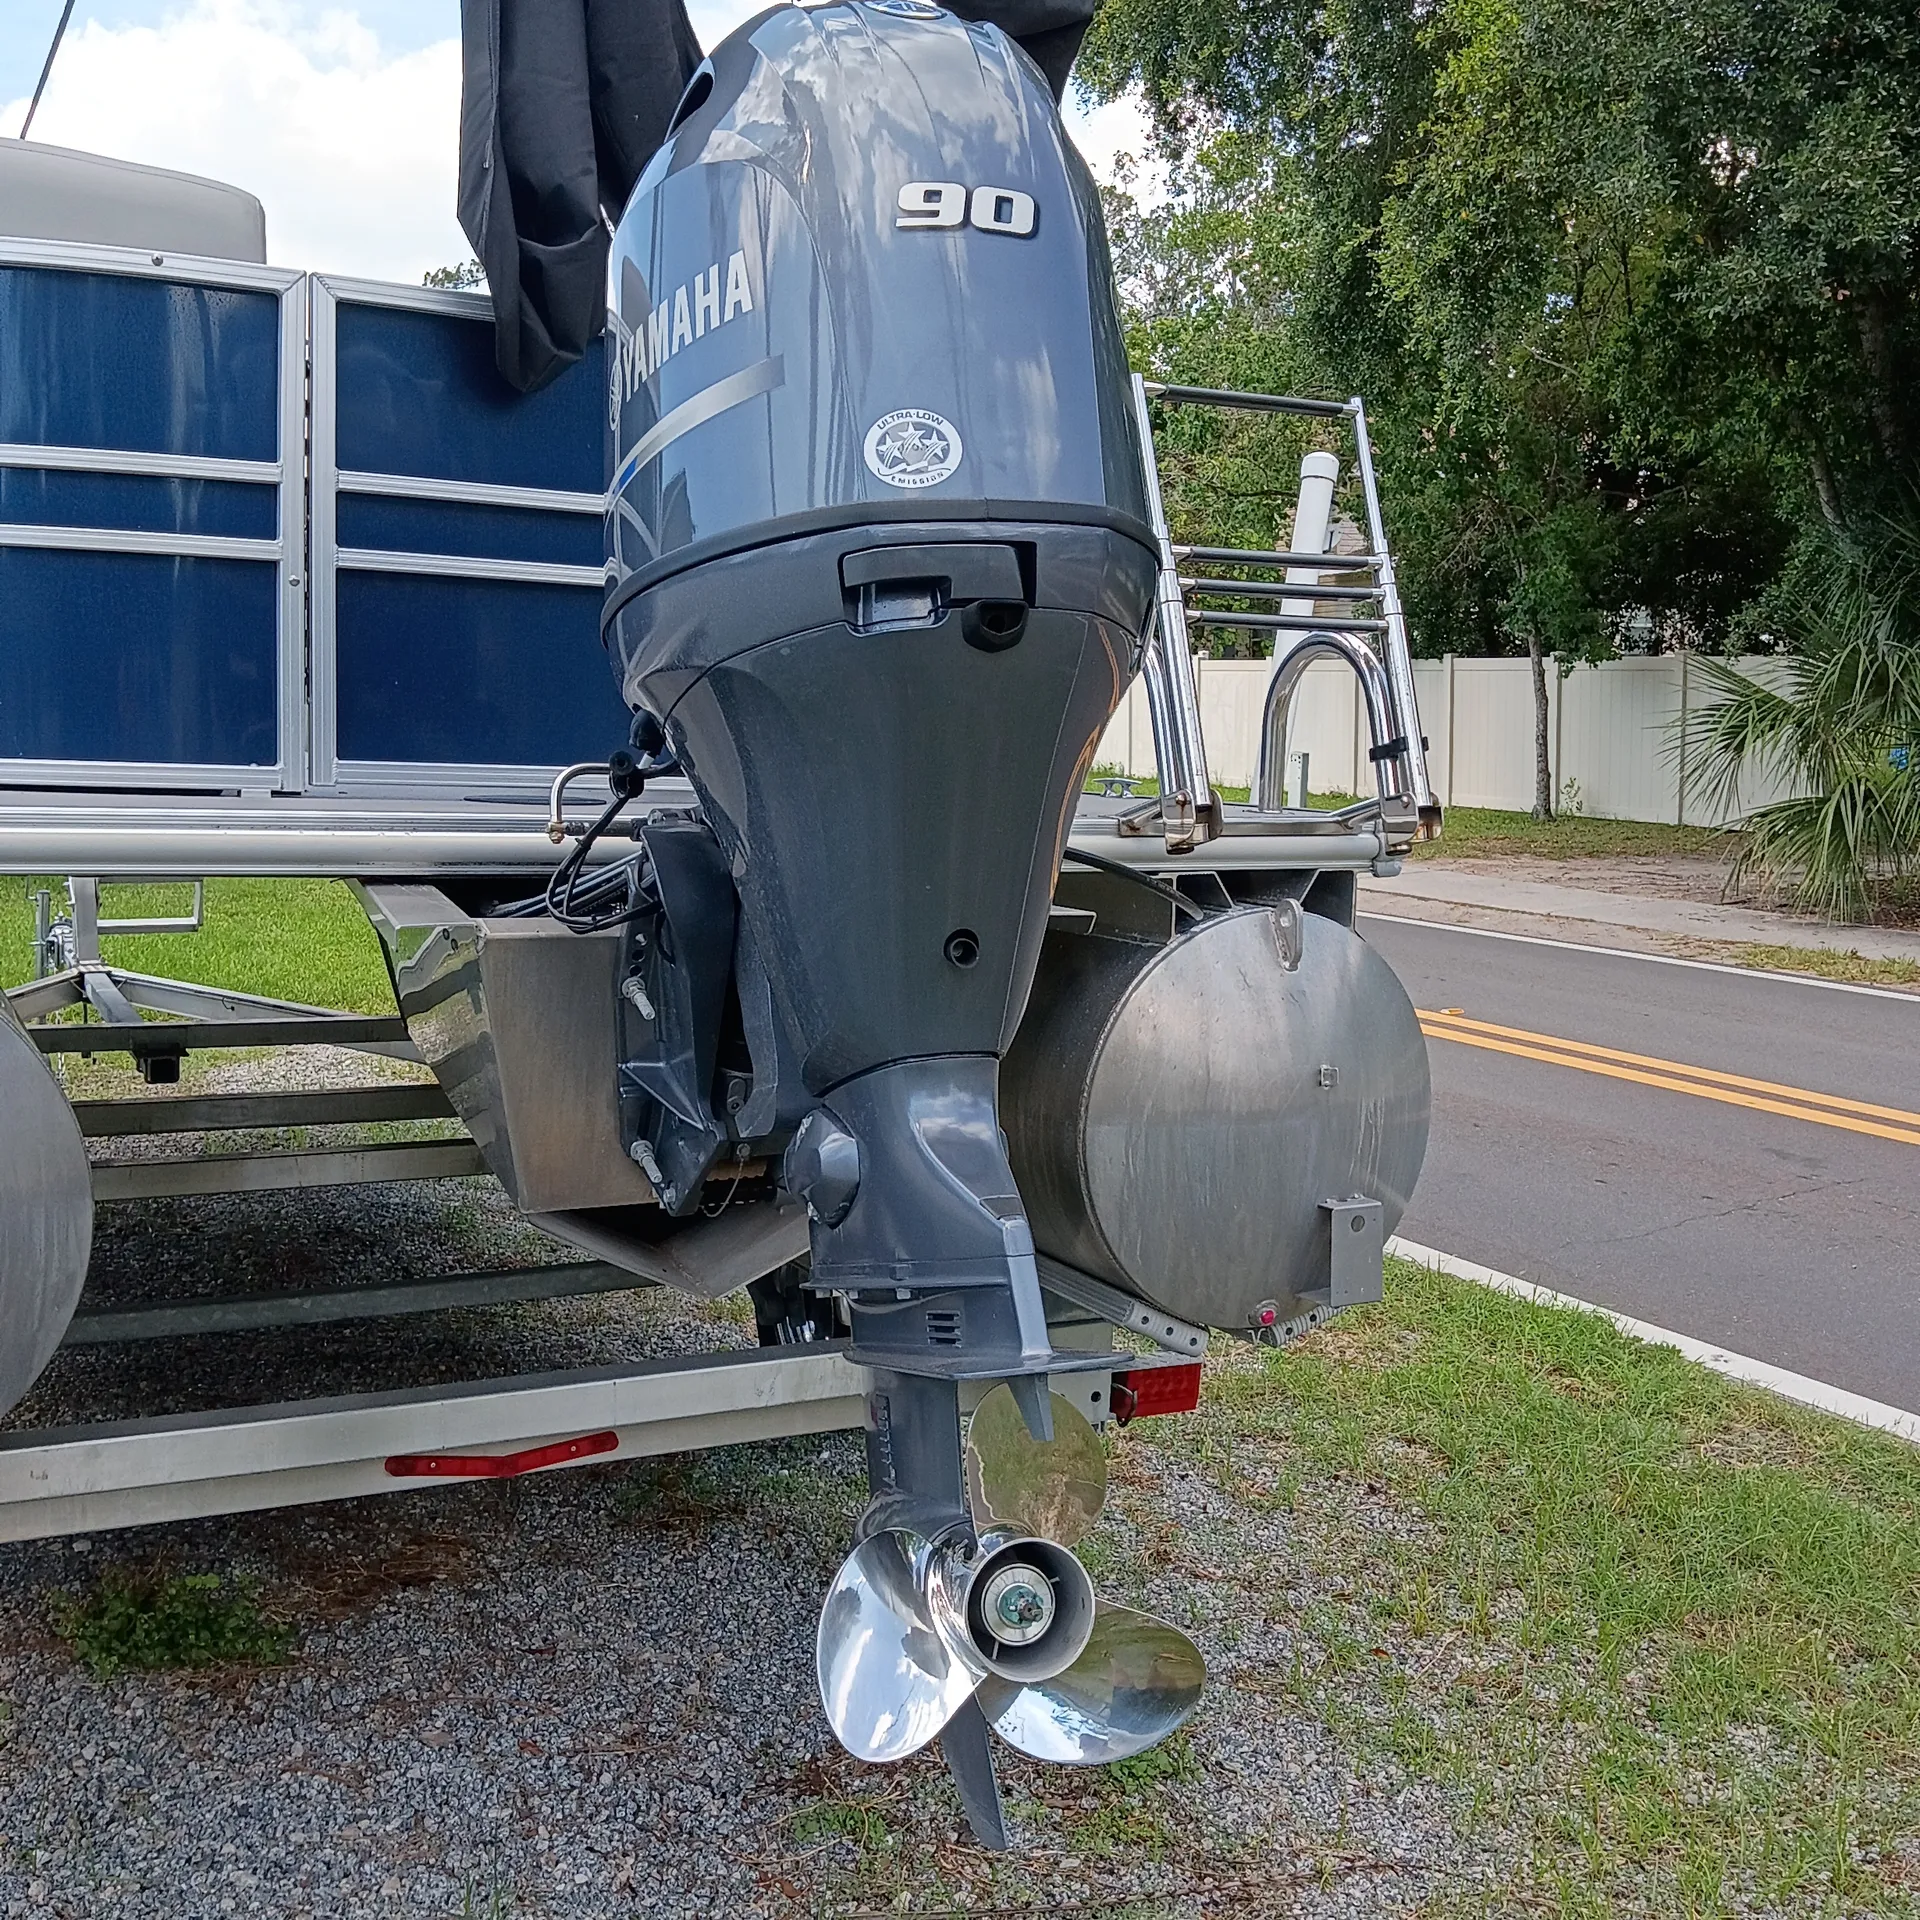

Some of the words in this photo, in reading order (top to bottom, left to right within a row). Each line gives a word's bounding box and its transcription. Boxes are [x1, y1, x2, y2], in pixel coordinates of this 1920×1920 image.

[895, 181, 1038, 238] 90
[622, 249, 754, 403] YAMAHA
[891, 472, 944, 485] EMISSION
